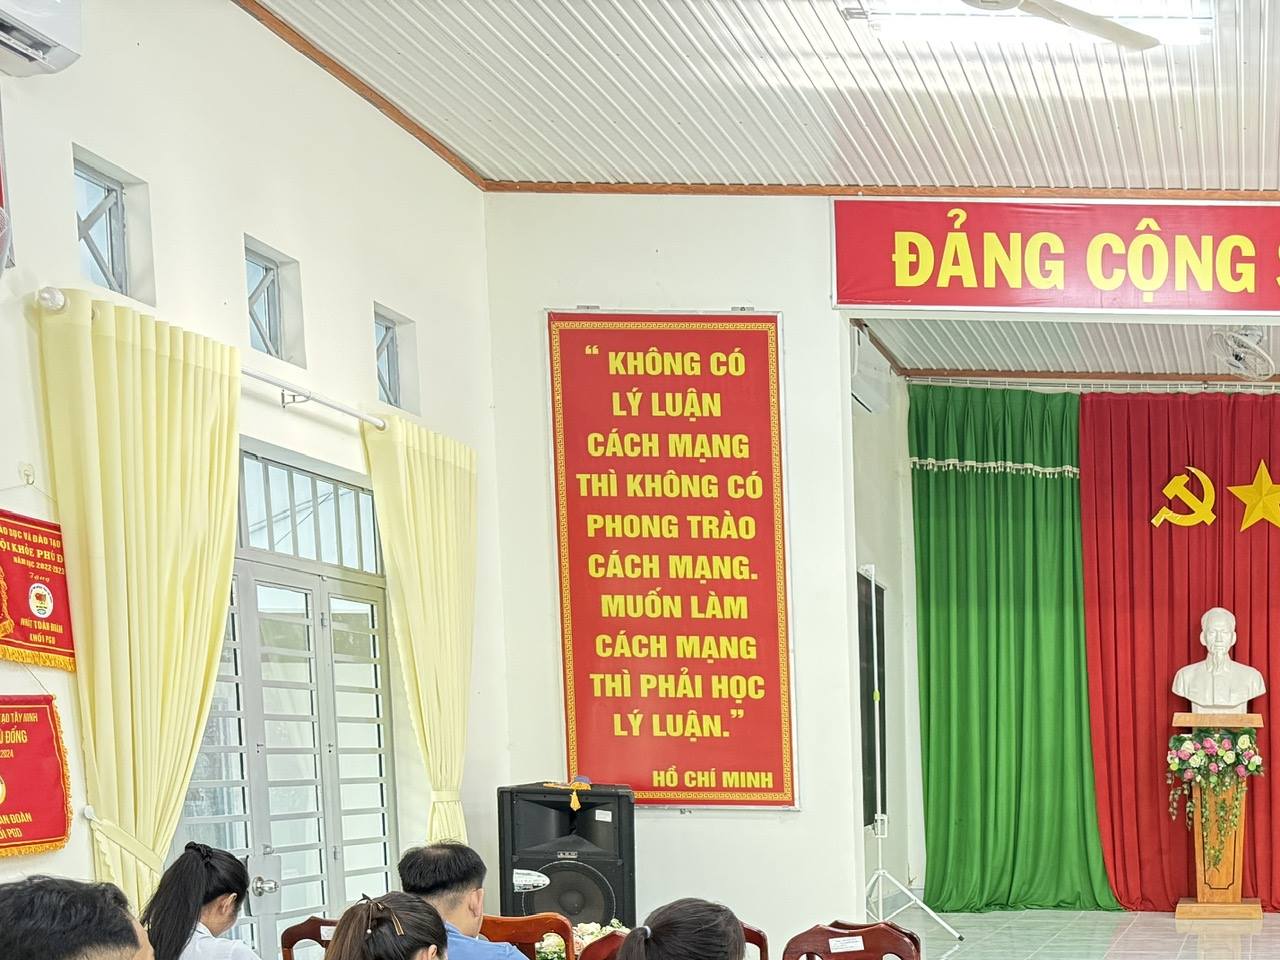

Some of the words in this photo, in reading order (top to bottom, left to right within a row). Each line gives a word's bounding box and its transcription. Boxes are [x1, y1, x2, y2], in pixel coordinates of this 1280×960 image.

[892, 208, 1065, 289] ĐẢNG
[1086, 217, 1256, 303] CỘNG
[608, 347, 701, 376] KHÔNG
[710, 347, 746, 377] CÓ
[612, 387, 643, 416] LÝ
[651, 388, 721, 422] LUẬN
[587, 428, 660, 457] CÁCH
[668, 433, 749, 463] MẠNG
[575, 468, 618, 497] THÌ
[626, 469, 719, 498] KHÔNG
[727, 471, 763, 499] CÓ
[586, 514, 679, 538] PHONG
[686, 510, 756, 540] TRÀO
[588, 550, 660, 579] CÁCH
[668, 554, 758, 584] MẠNG.
[601, 587, 682, 618] MUỐN
[690, 590, 748, 619] LÀM
[595, 630, 667, 658] CÁCH
[676, 635, 757, 664] MẠNG
[589, 669, 631, 697] THÌ
[639, 667, 702, 698] PHẢI
[711, 675, 765, 704] HỌC
[613, 709, 643, 736] LÝ
[652, 765, 679, 787] HỒ
[684, 768, 716, 788] CHÍ
[722, 771, 773, 788] MINH
